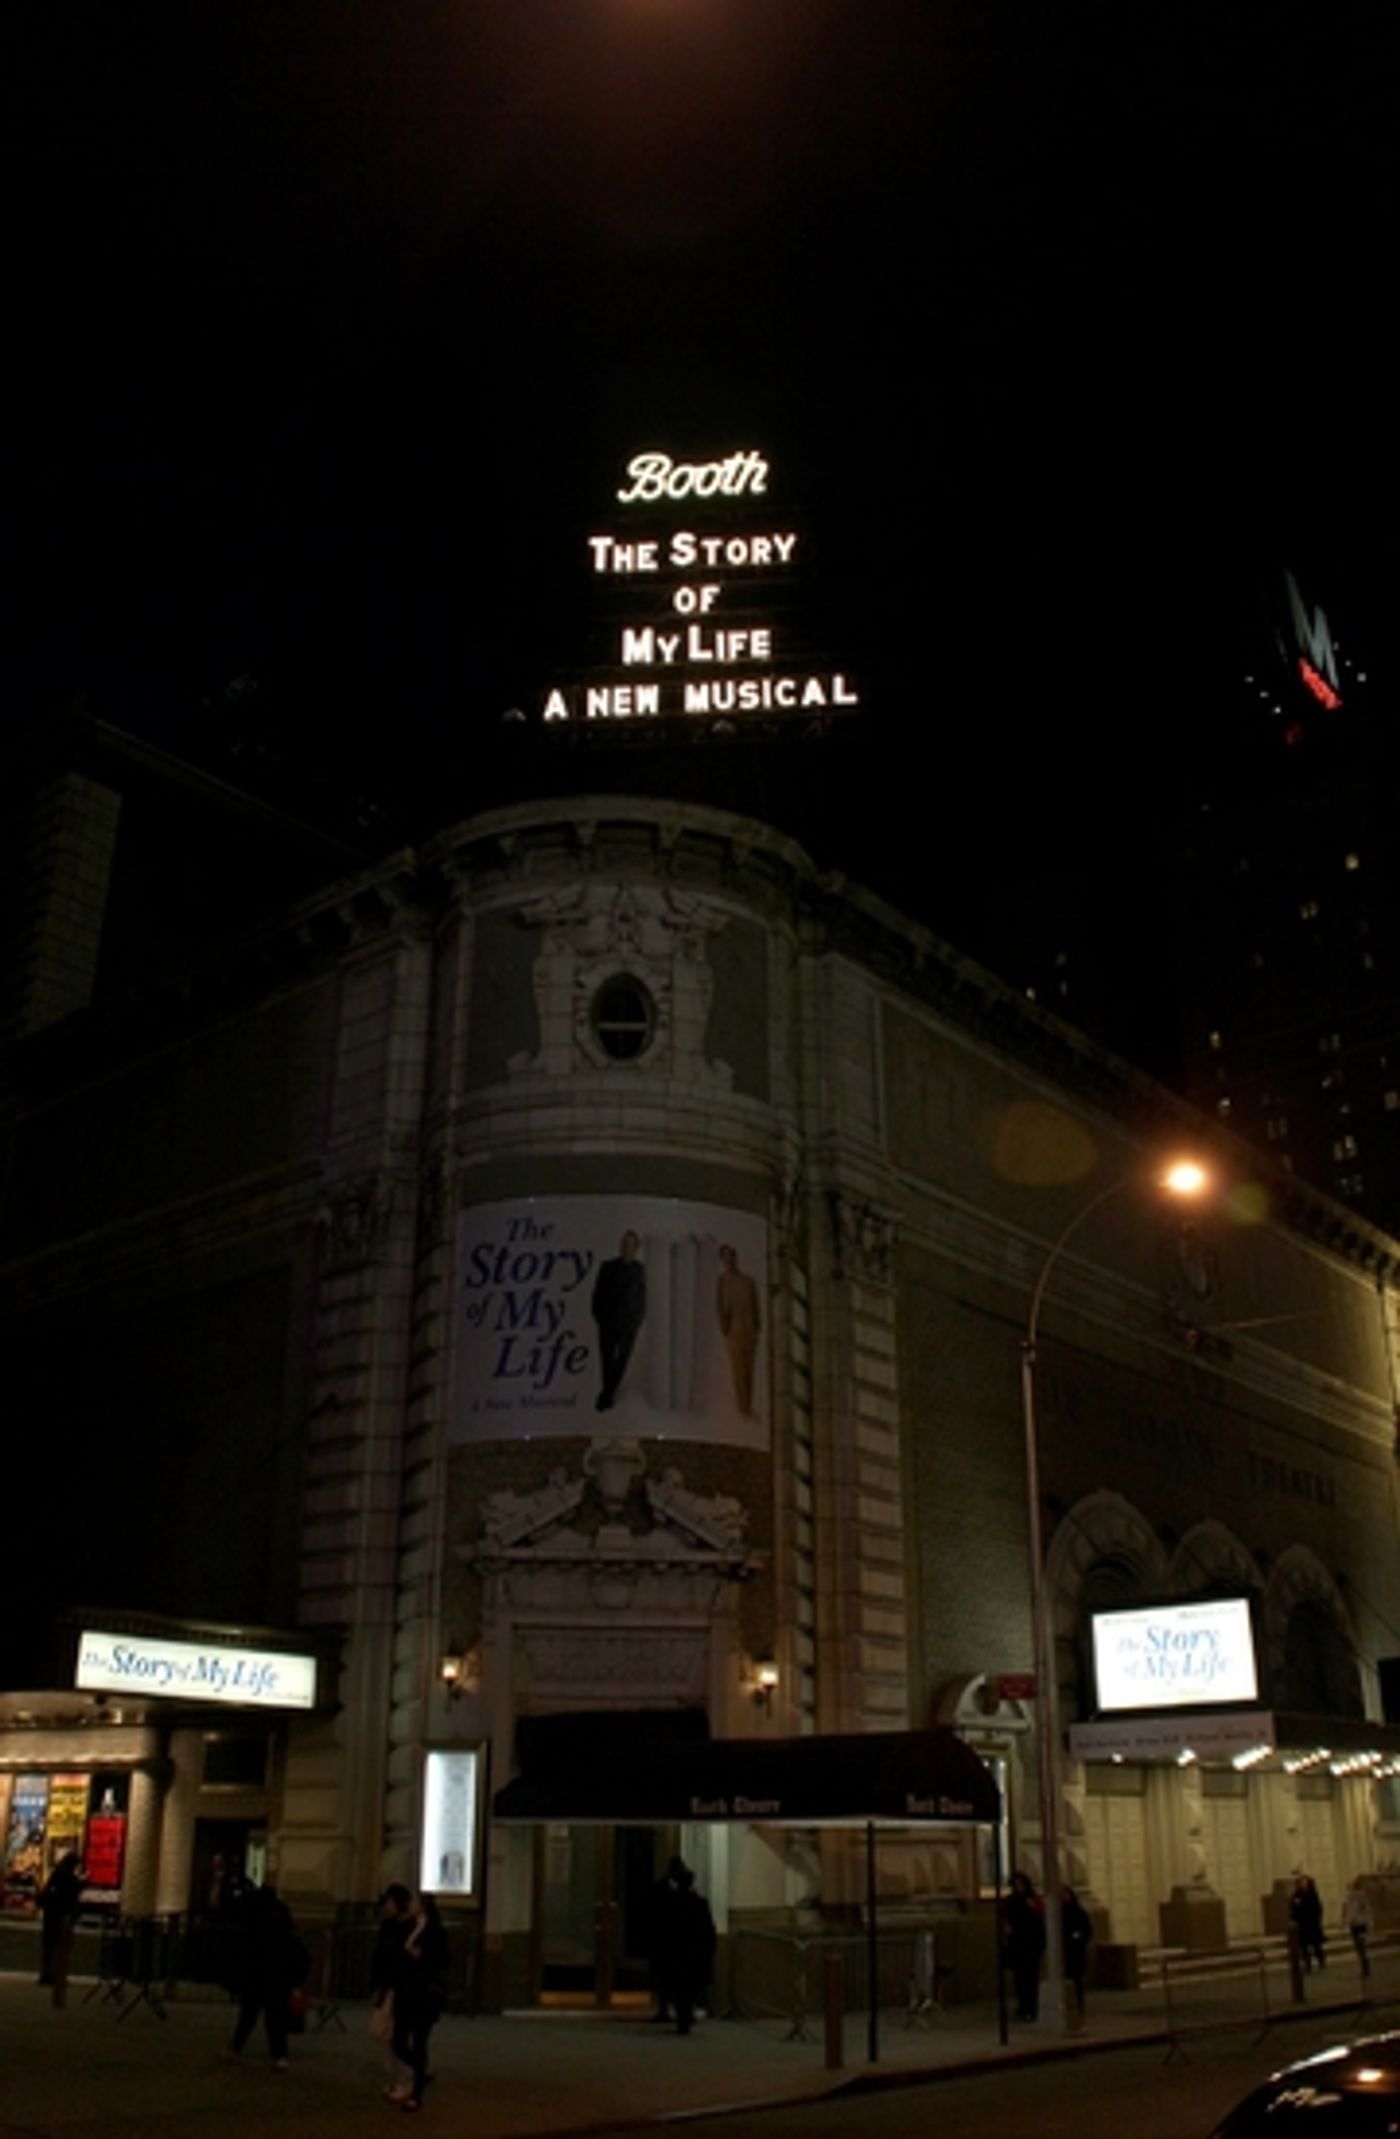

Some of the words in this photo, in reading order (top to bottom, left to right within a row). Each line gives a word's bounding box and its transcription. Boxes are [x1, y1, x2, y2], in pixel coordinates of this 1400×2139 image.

[617, 450, 769, 502] Booth
[588, 536, 658, 573] THE
[669, 531, 796, 567] STORY
[673, 584, 721, 614] OF
[621, 626, 680, 665] MY
[688, 624, 771, 662] LIFE
[543, 688, 568, 720] A
[586, 684, 659, 717] NEW
[683, 675, 859, 713] MUSICAL
[507, 1217, 554, 1242] The
[466, 1243, 593, 1293] Story
[466, 1293, 494, 1328] of
[494, 1289, 566, 1342] My
[492, 1331, 590, 1390] Life
[1142, 1624, 1221, 1653] Story
[109, 1644, 173, 1686] Story
[190, 1655, 231, 1693] My
[230, 1659, 280, 1696] Life
